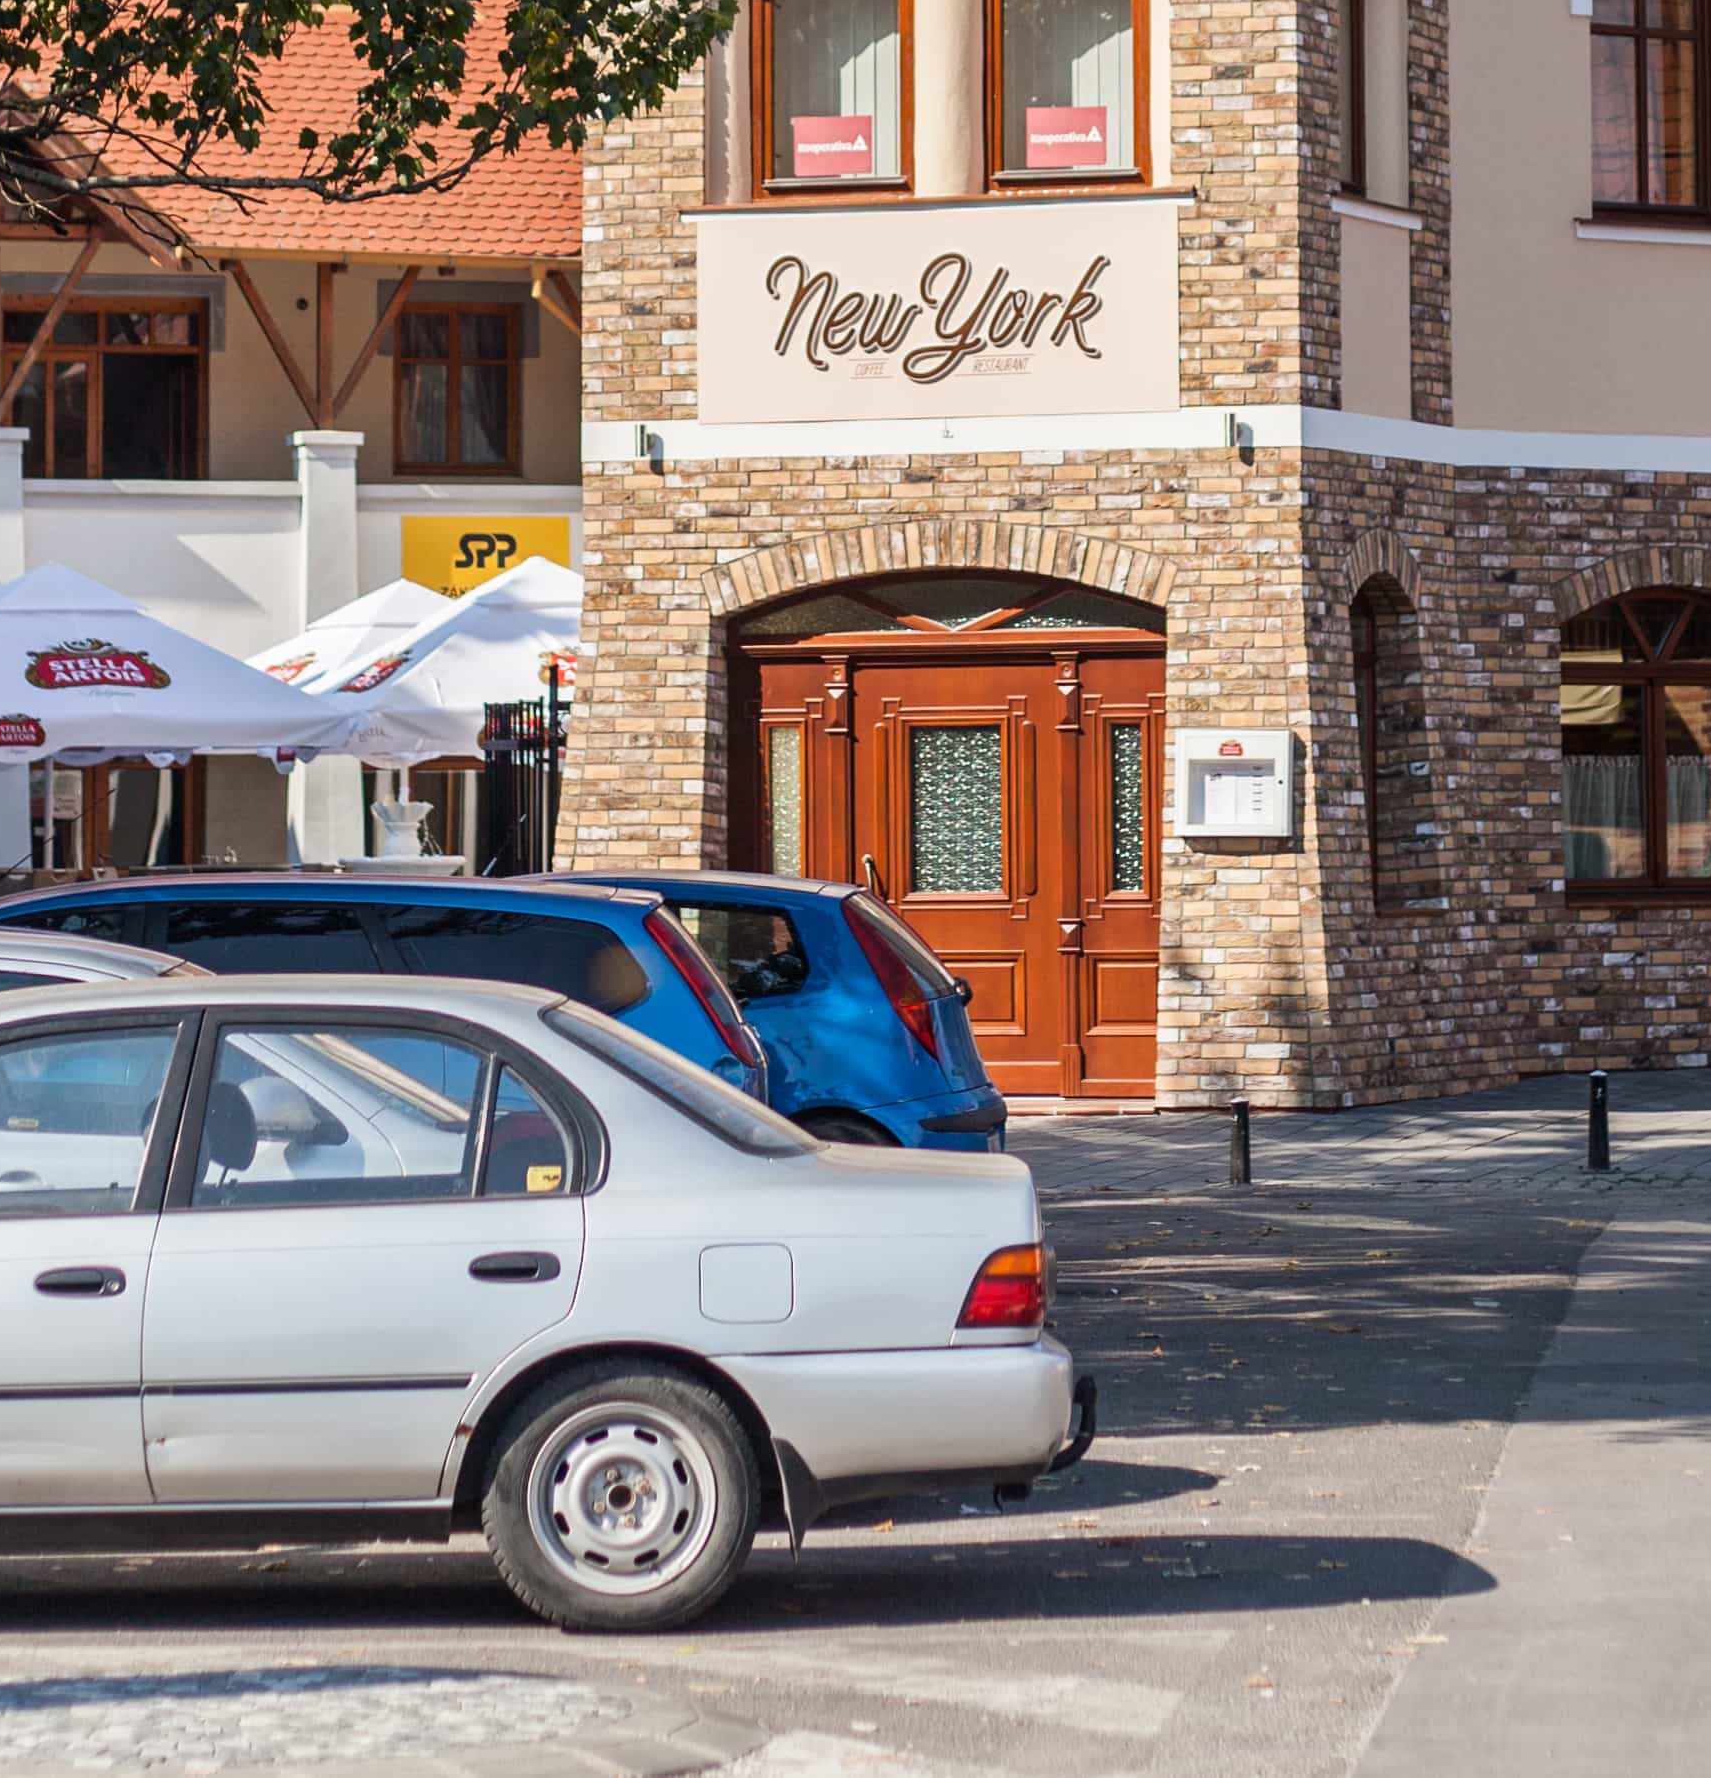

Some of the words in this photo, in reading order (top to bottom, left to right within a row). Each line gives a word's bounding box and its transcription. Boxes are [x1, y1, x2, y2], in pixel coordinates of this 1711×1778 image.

[766, 254, 923, 371] New
[903, 252, 1111, 385] York
[454, 533, 517, 568] SPP
[48, 657, 141, 671] STELLA
[53, 669, 146, 683] ARTOIS
